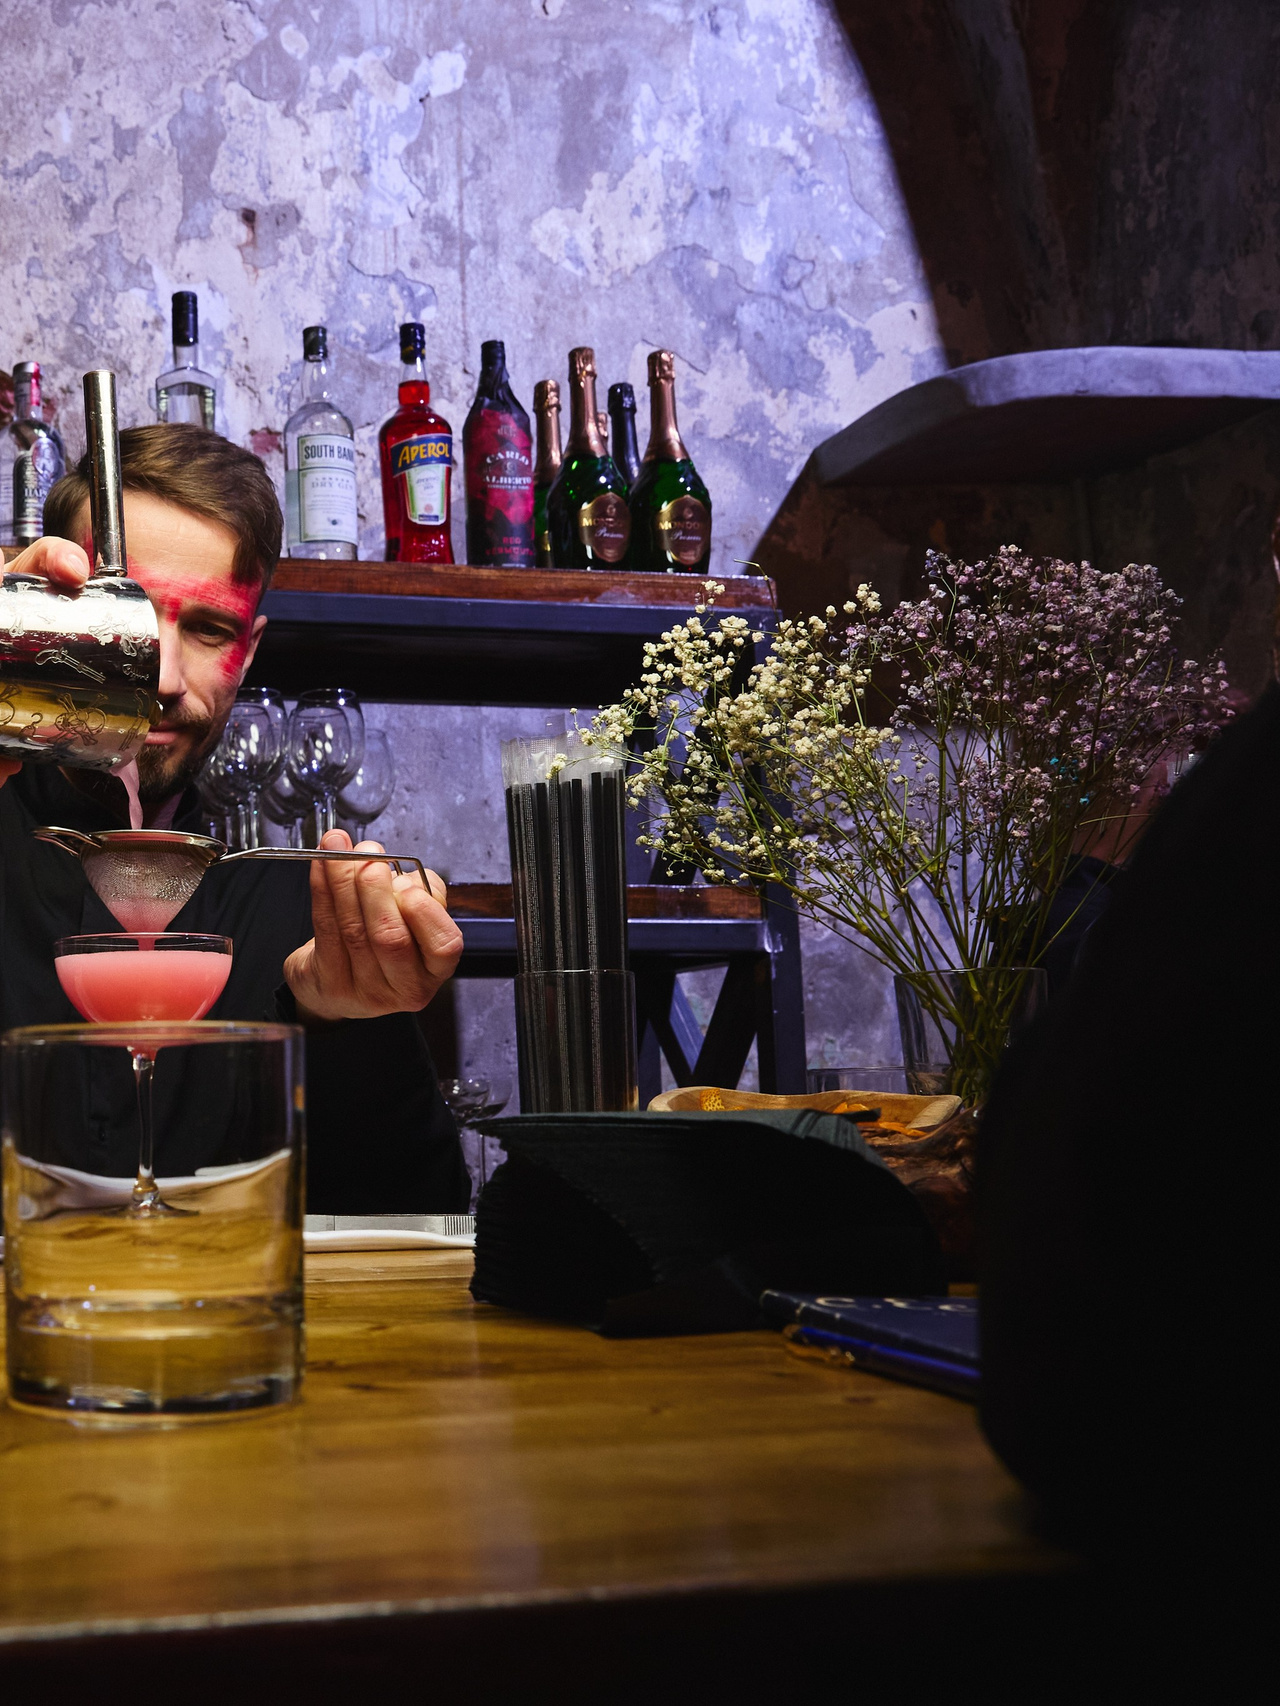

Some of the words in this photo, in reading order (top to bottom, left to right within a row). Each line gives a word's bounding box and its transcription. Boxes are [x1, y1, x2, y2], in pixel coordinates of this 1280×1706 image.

[304, 445, 334, 460] SOUTH
[337, 446, 354, 462] BAN
[398, 442, 450, 468] APEROL
[486, 450, 529, 466] CARLO
